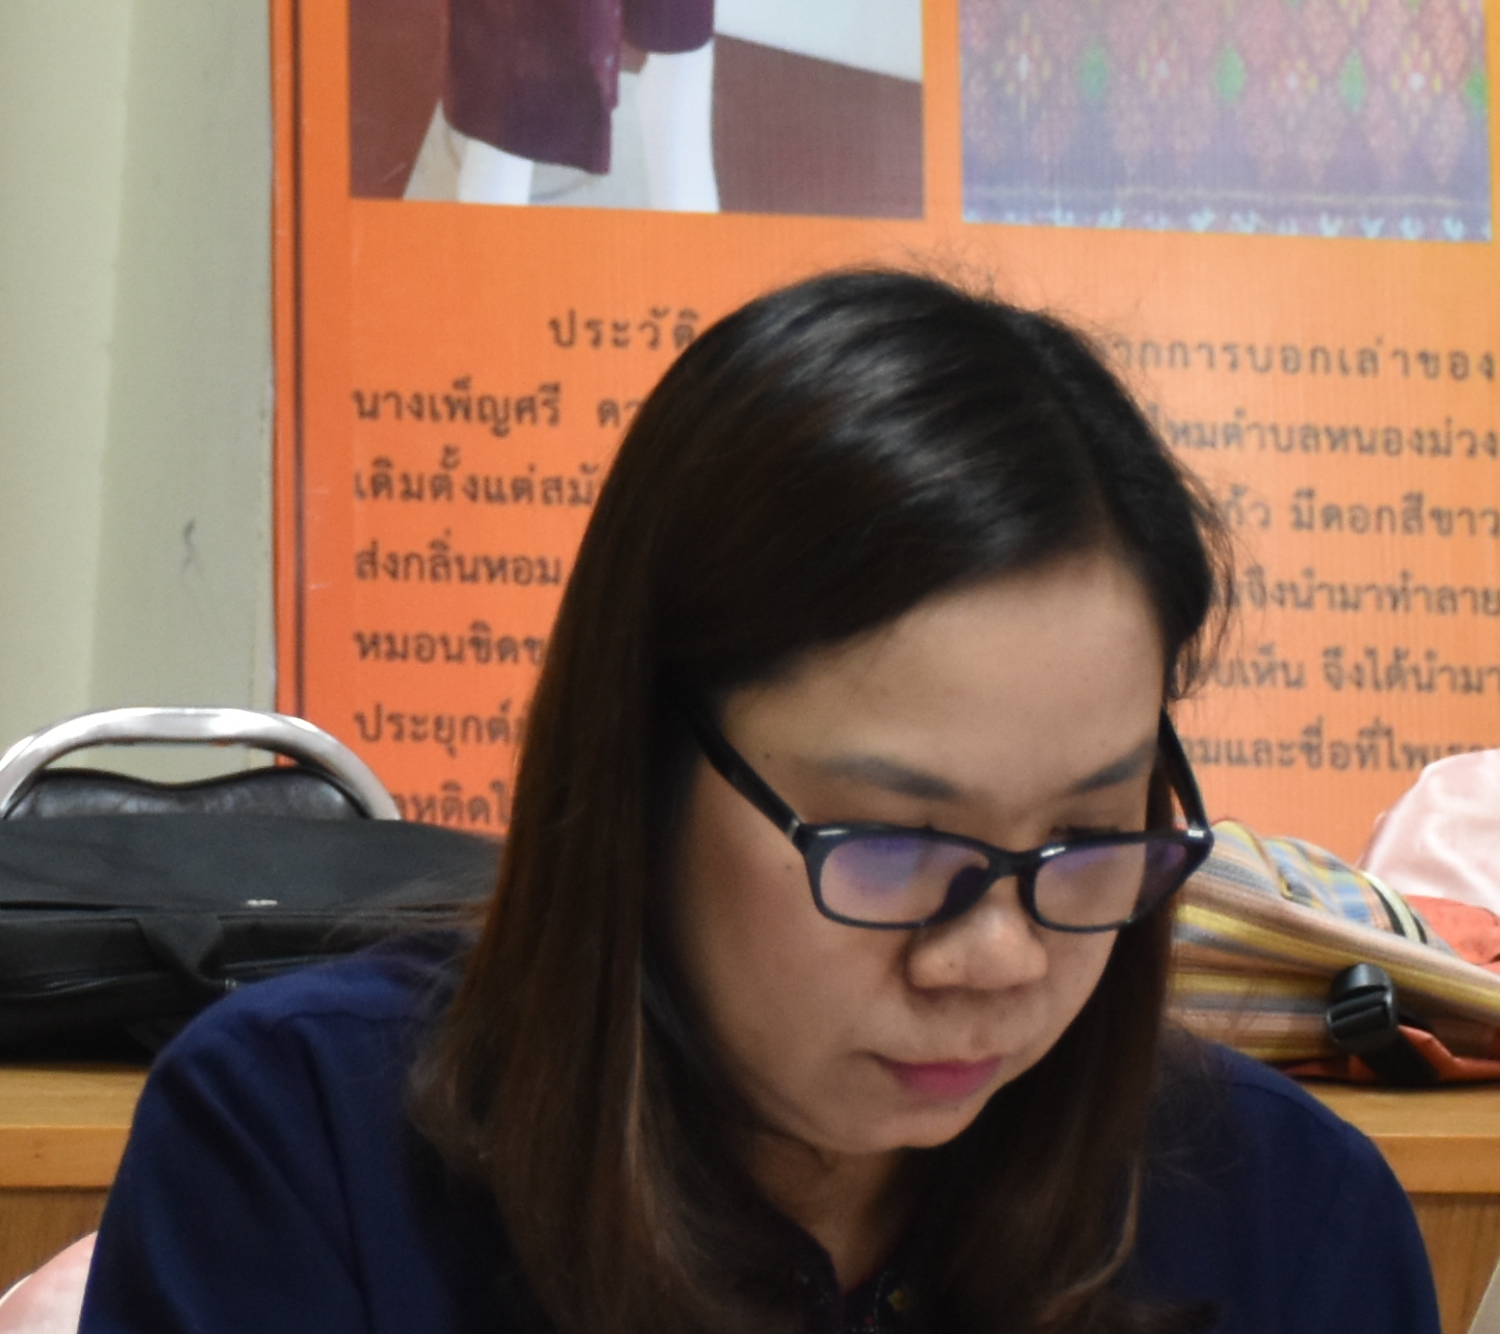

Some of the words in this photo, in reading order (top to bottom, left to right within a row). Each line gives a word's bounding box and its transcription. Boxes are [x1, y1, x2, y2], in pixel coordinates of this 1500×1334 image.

[548, 305, 702, 351] ประวัติ
[352, 376, 561, 438] นางเพ็ญศรี
[353, 443, 599, 507] เดิมตั้งแต่สมั
[354, 528, 562, 587] ส่งกลิ่นหอม
[354, 620, 548, 667] หมอนขิดข
